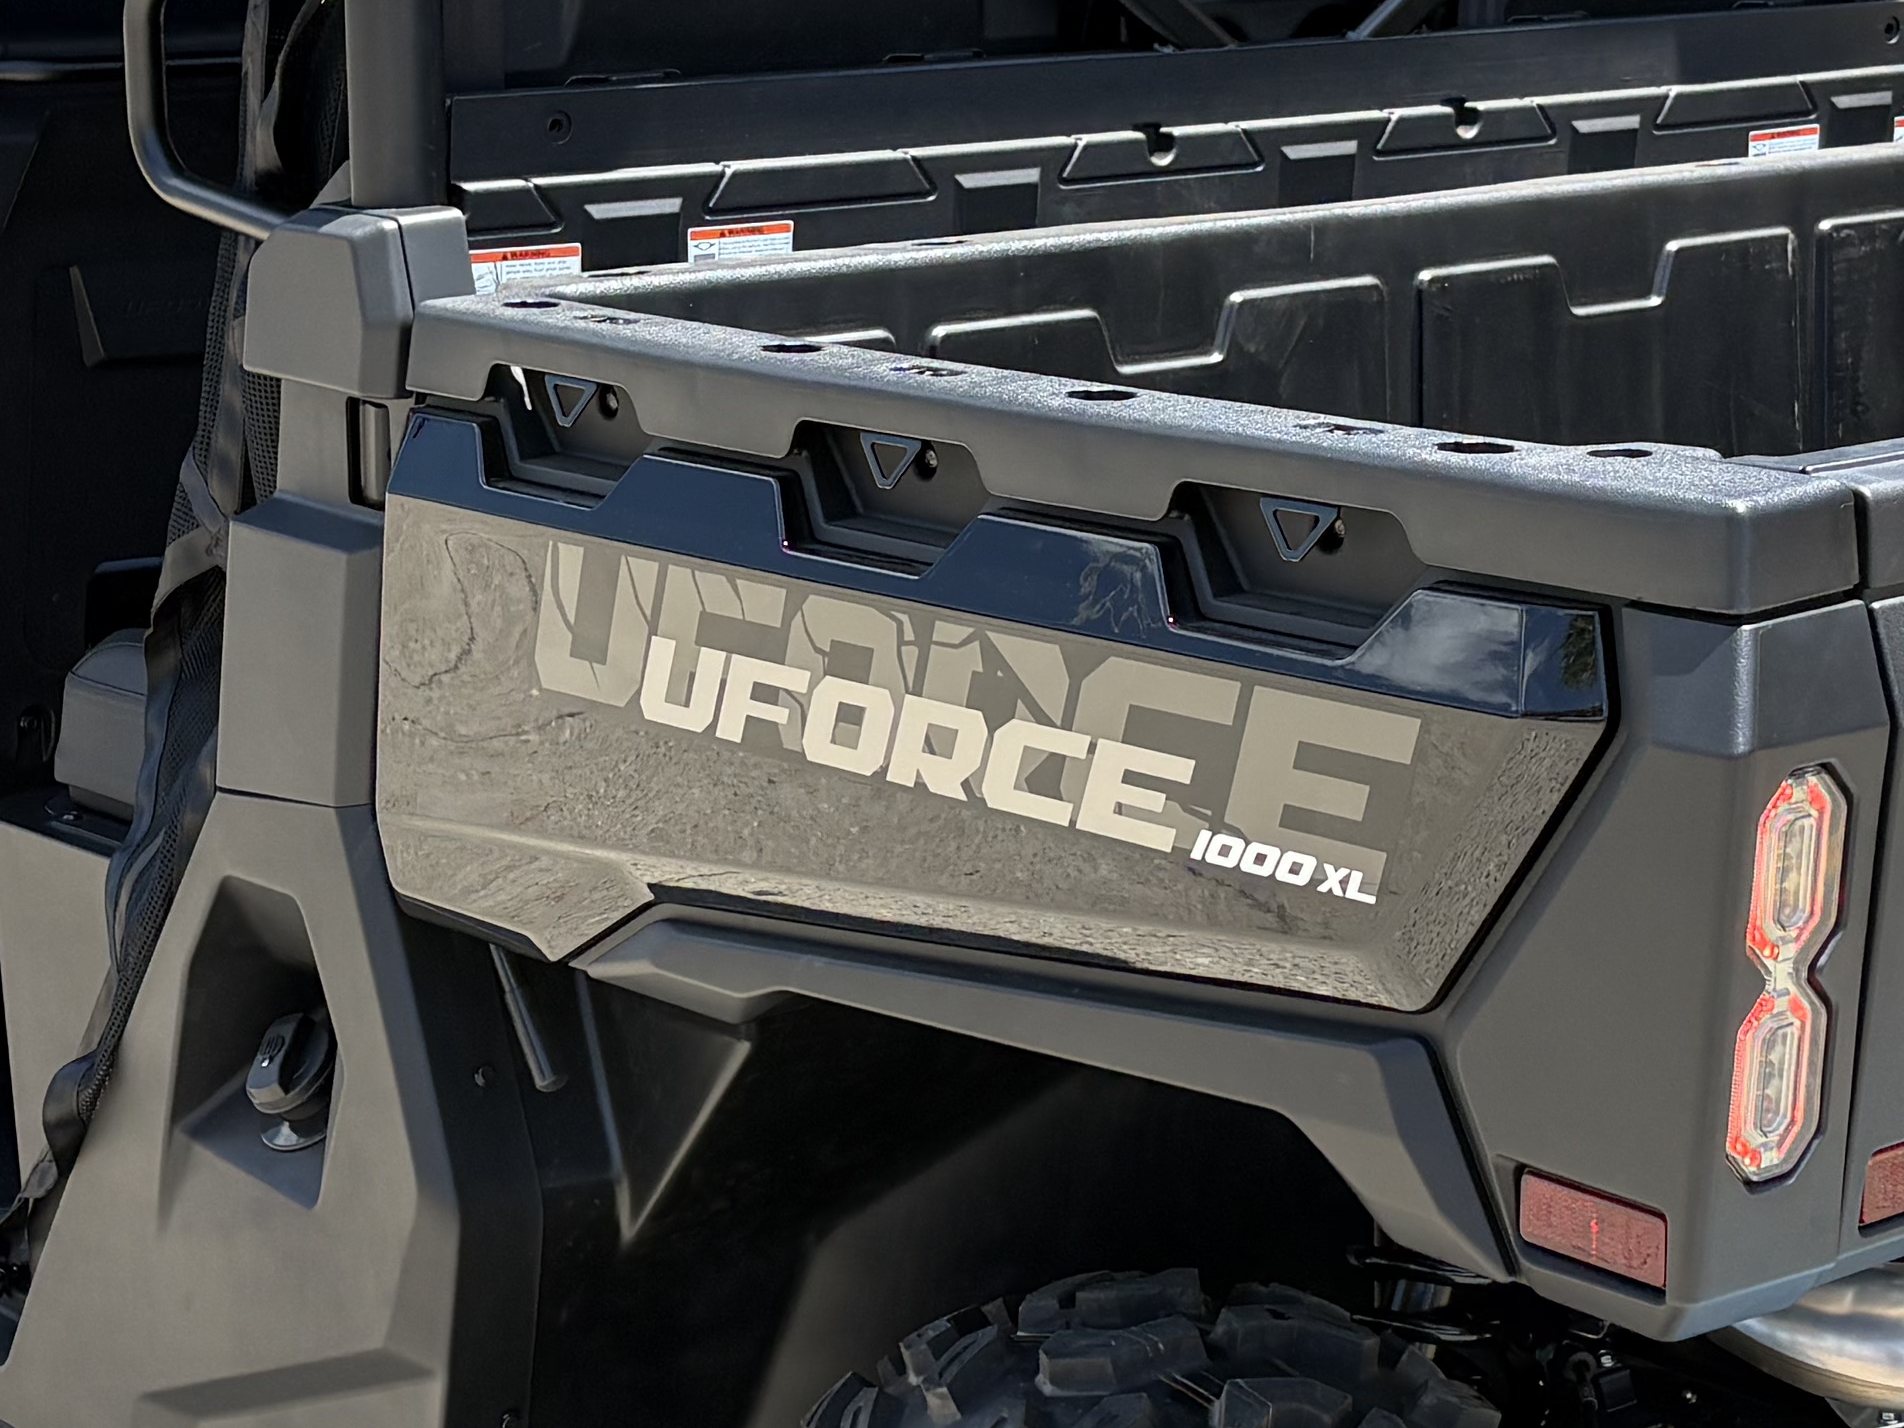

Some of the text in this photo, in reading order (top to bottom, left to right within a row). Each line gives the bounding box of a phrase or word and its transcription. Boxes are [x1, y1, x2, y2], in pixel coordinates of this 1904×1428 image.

[640, 635, 1196, 853] UFORCE
[1189, 828, 1378, 905] 1000 XL
